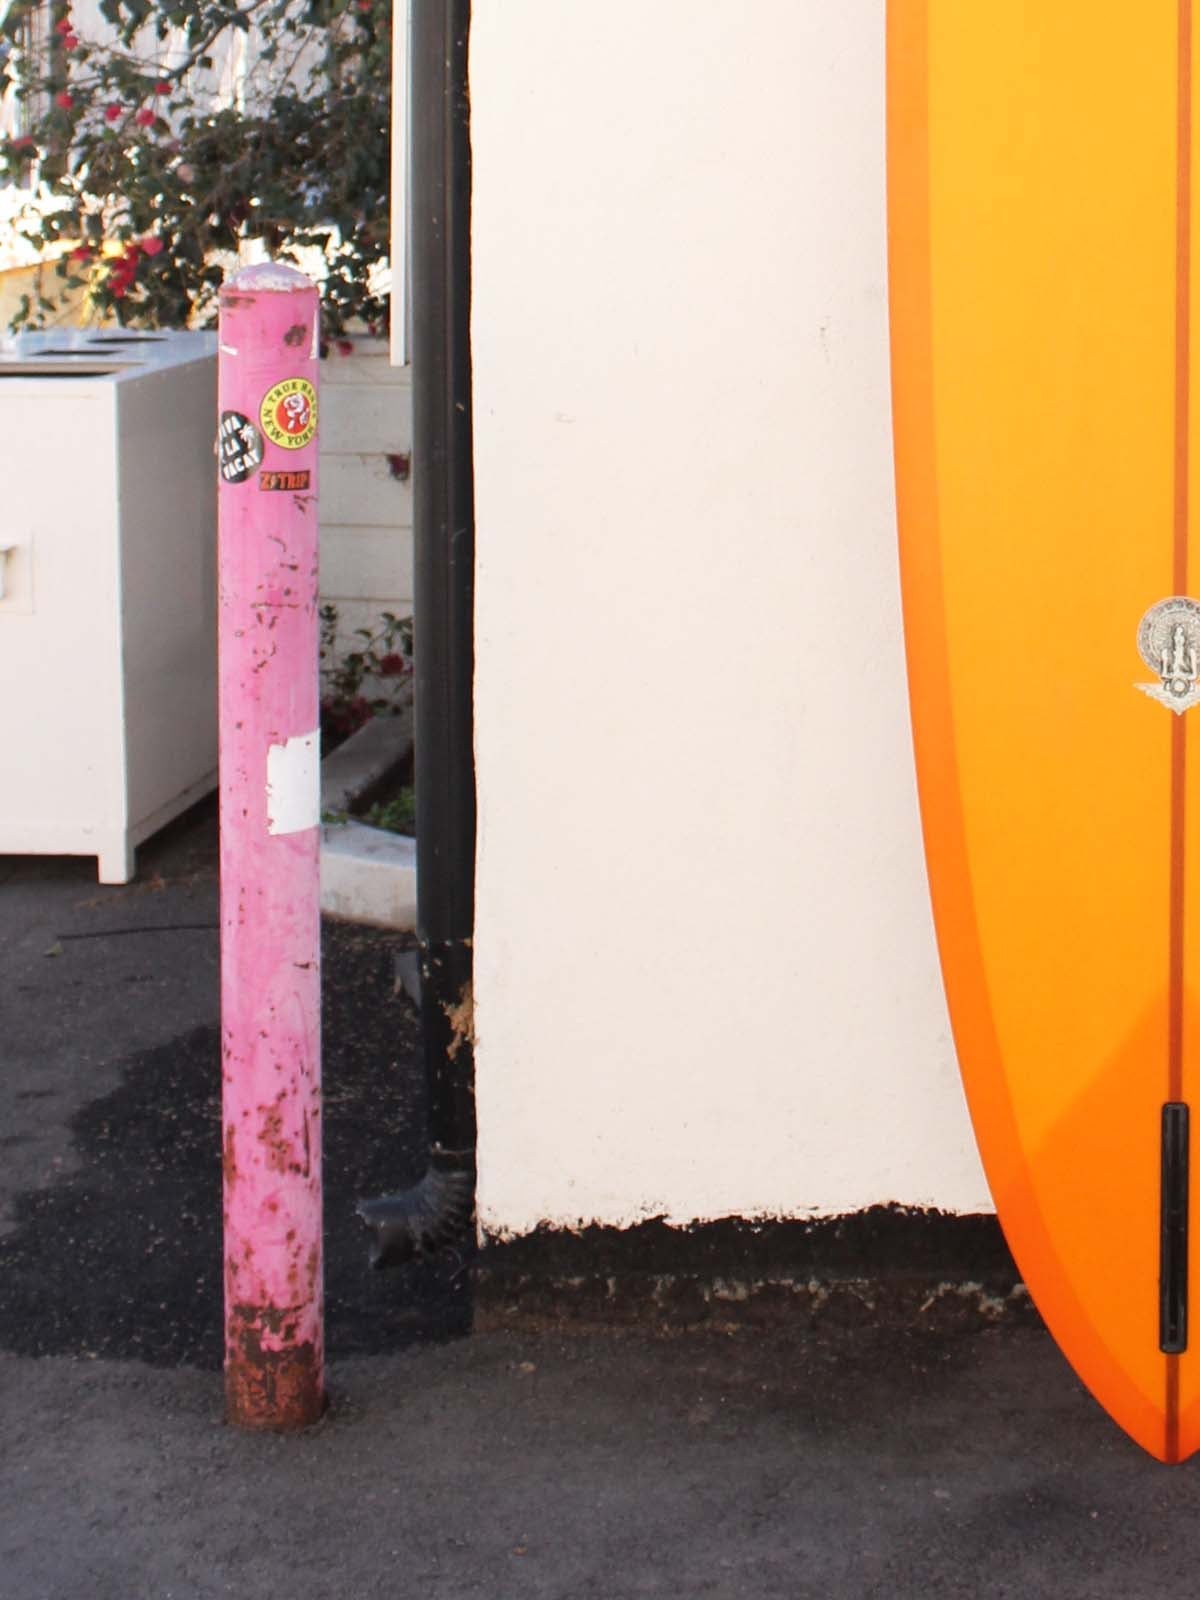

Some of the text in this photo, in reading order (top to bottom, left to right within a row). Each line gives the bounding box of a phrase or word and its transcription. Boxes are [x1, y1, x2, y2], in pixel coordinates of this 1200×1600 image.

[268, 382, 298, 403] TRUE
[220, 415, 242, 438] IVA
[263, 408, 314, 446] NEW YORK
[225, 438, 241, 457] LA
[223, 448, 260, 480] VACAY
